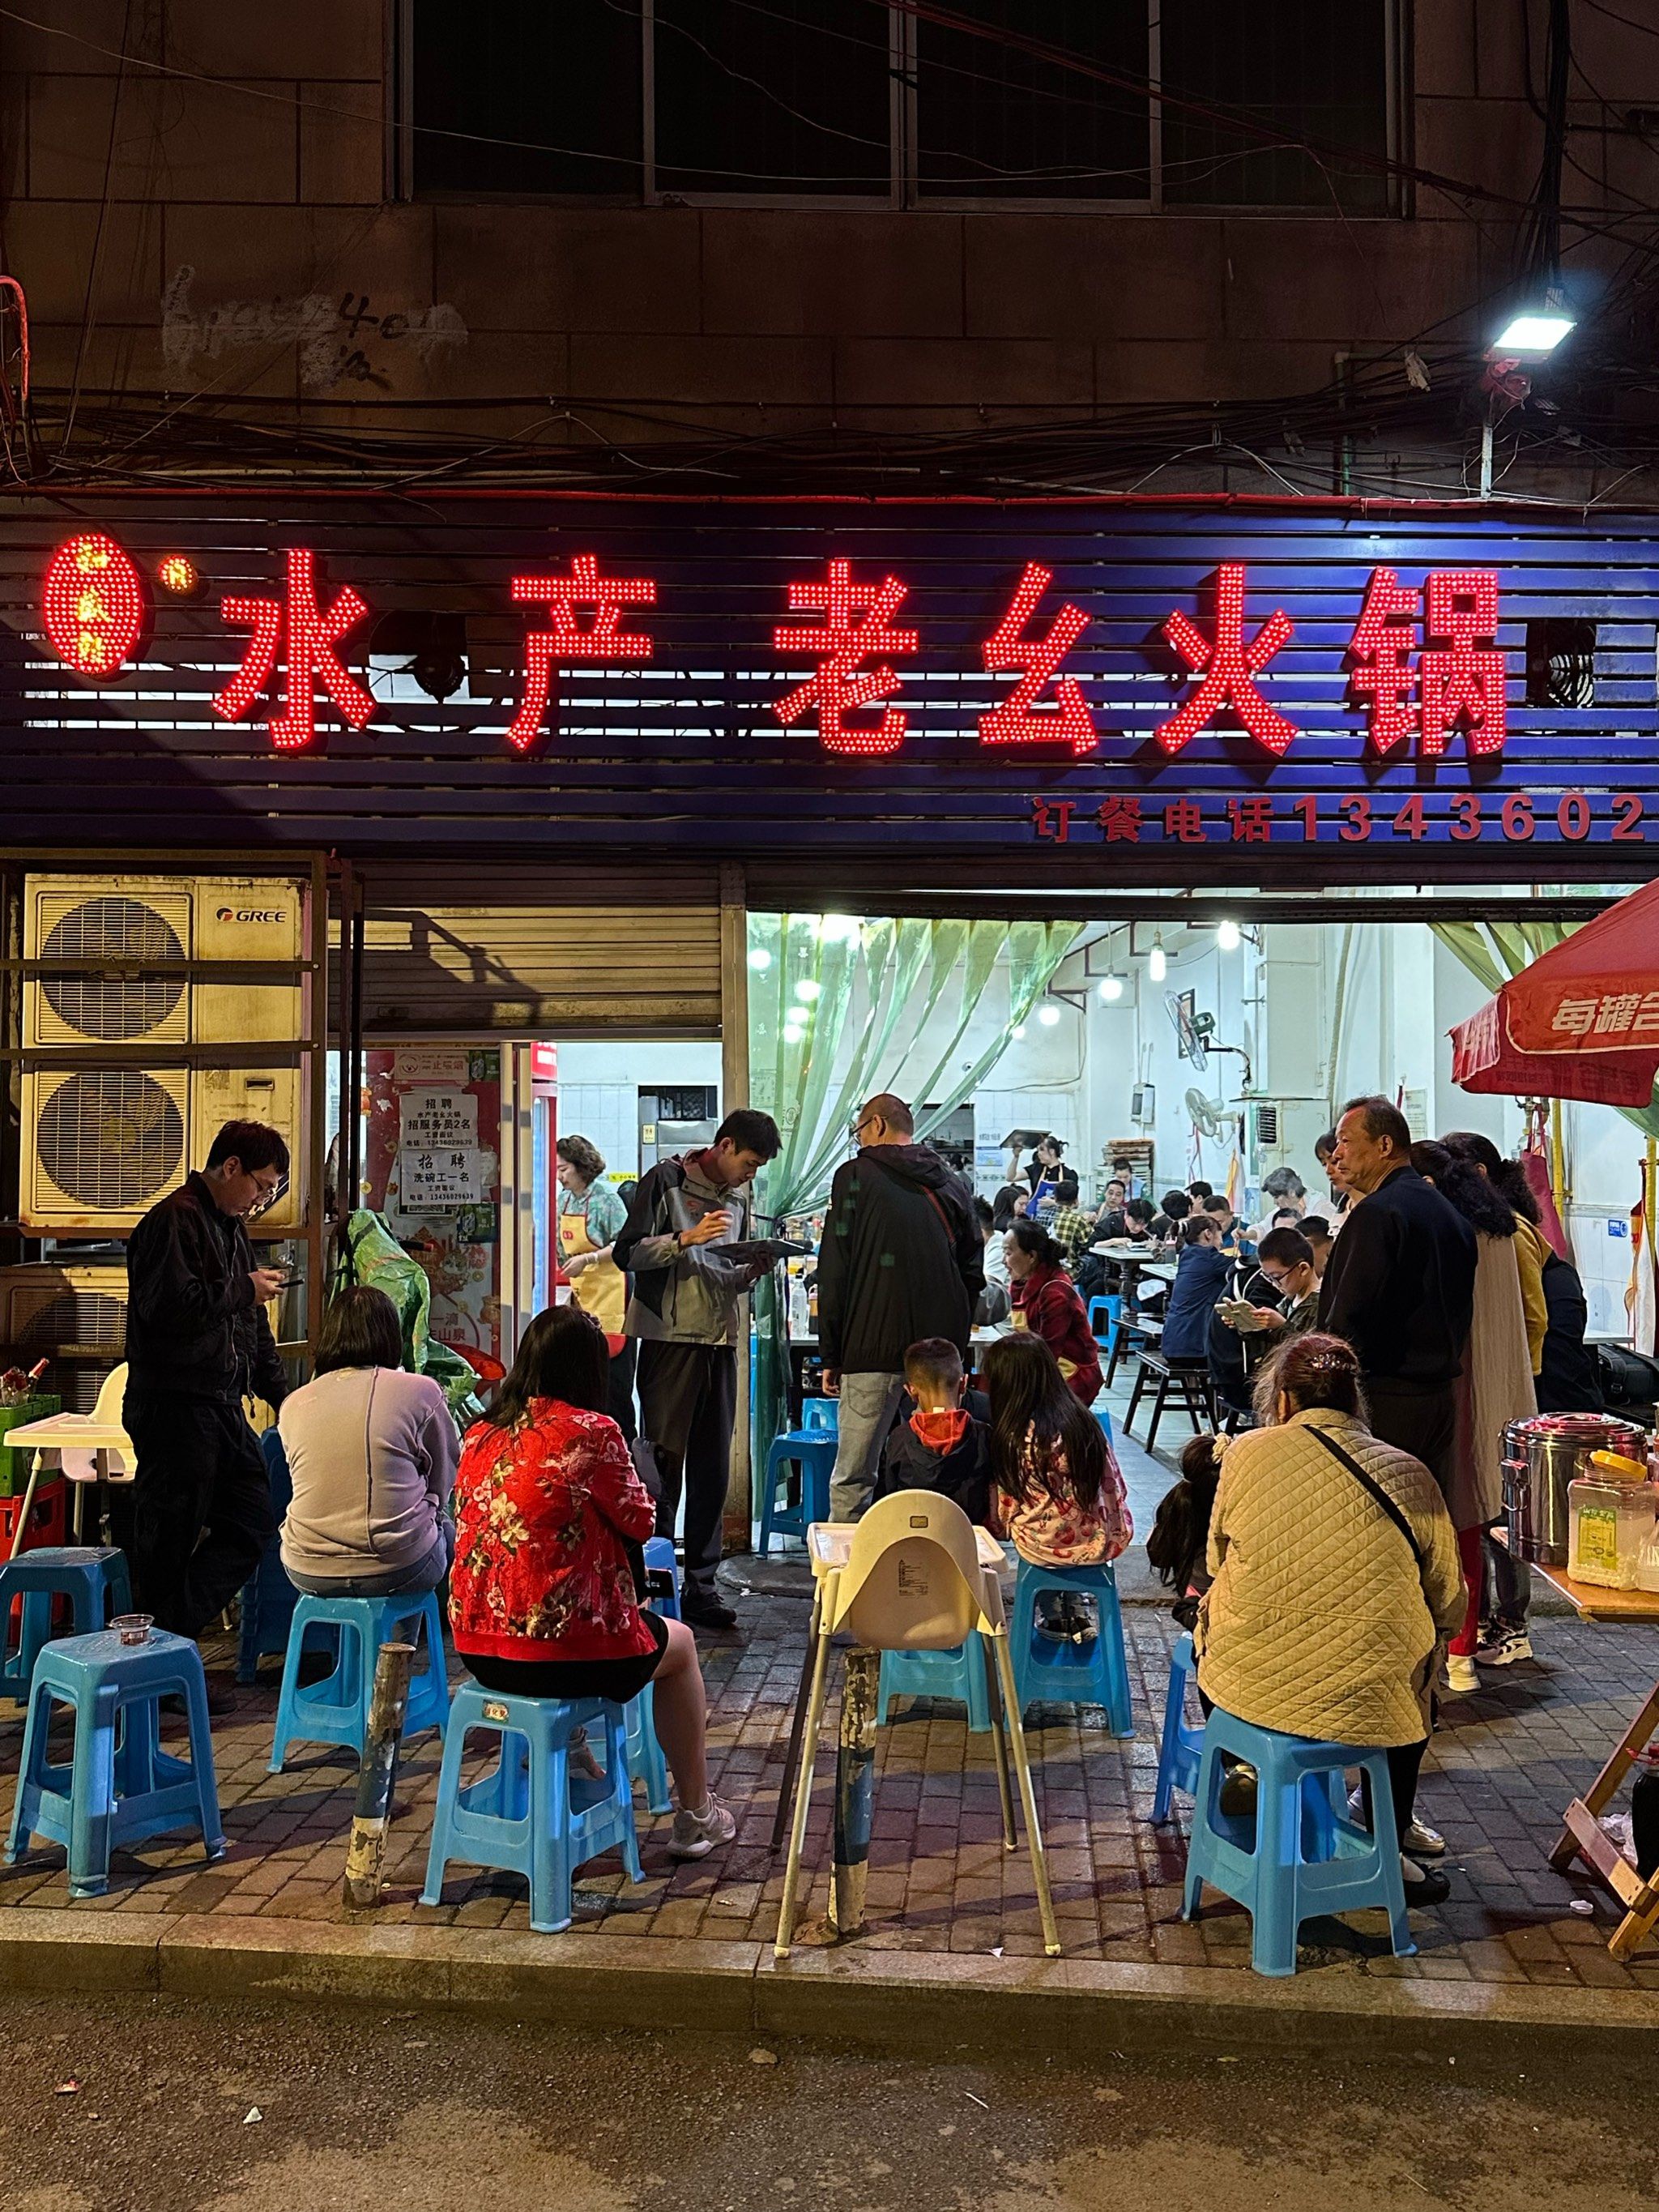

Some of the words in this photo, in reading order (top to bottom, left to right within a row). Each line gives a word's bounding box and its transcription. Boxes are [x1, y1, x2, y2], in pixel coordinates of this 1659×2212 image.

[236, 910, 288, 923] GREE
[425, 1098, 452, 1109] 招聘
[407, 1119, 471, 1130] 招服务员2名
[418, 1151, 467, 1170] 招聘
[413, 1172, 470, 1183] 洗碗工一名
